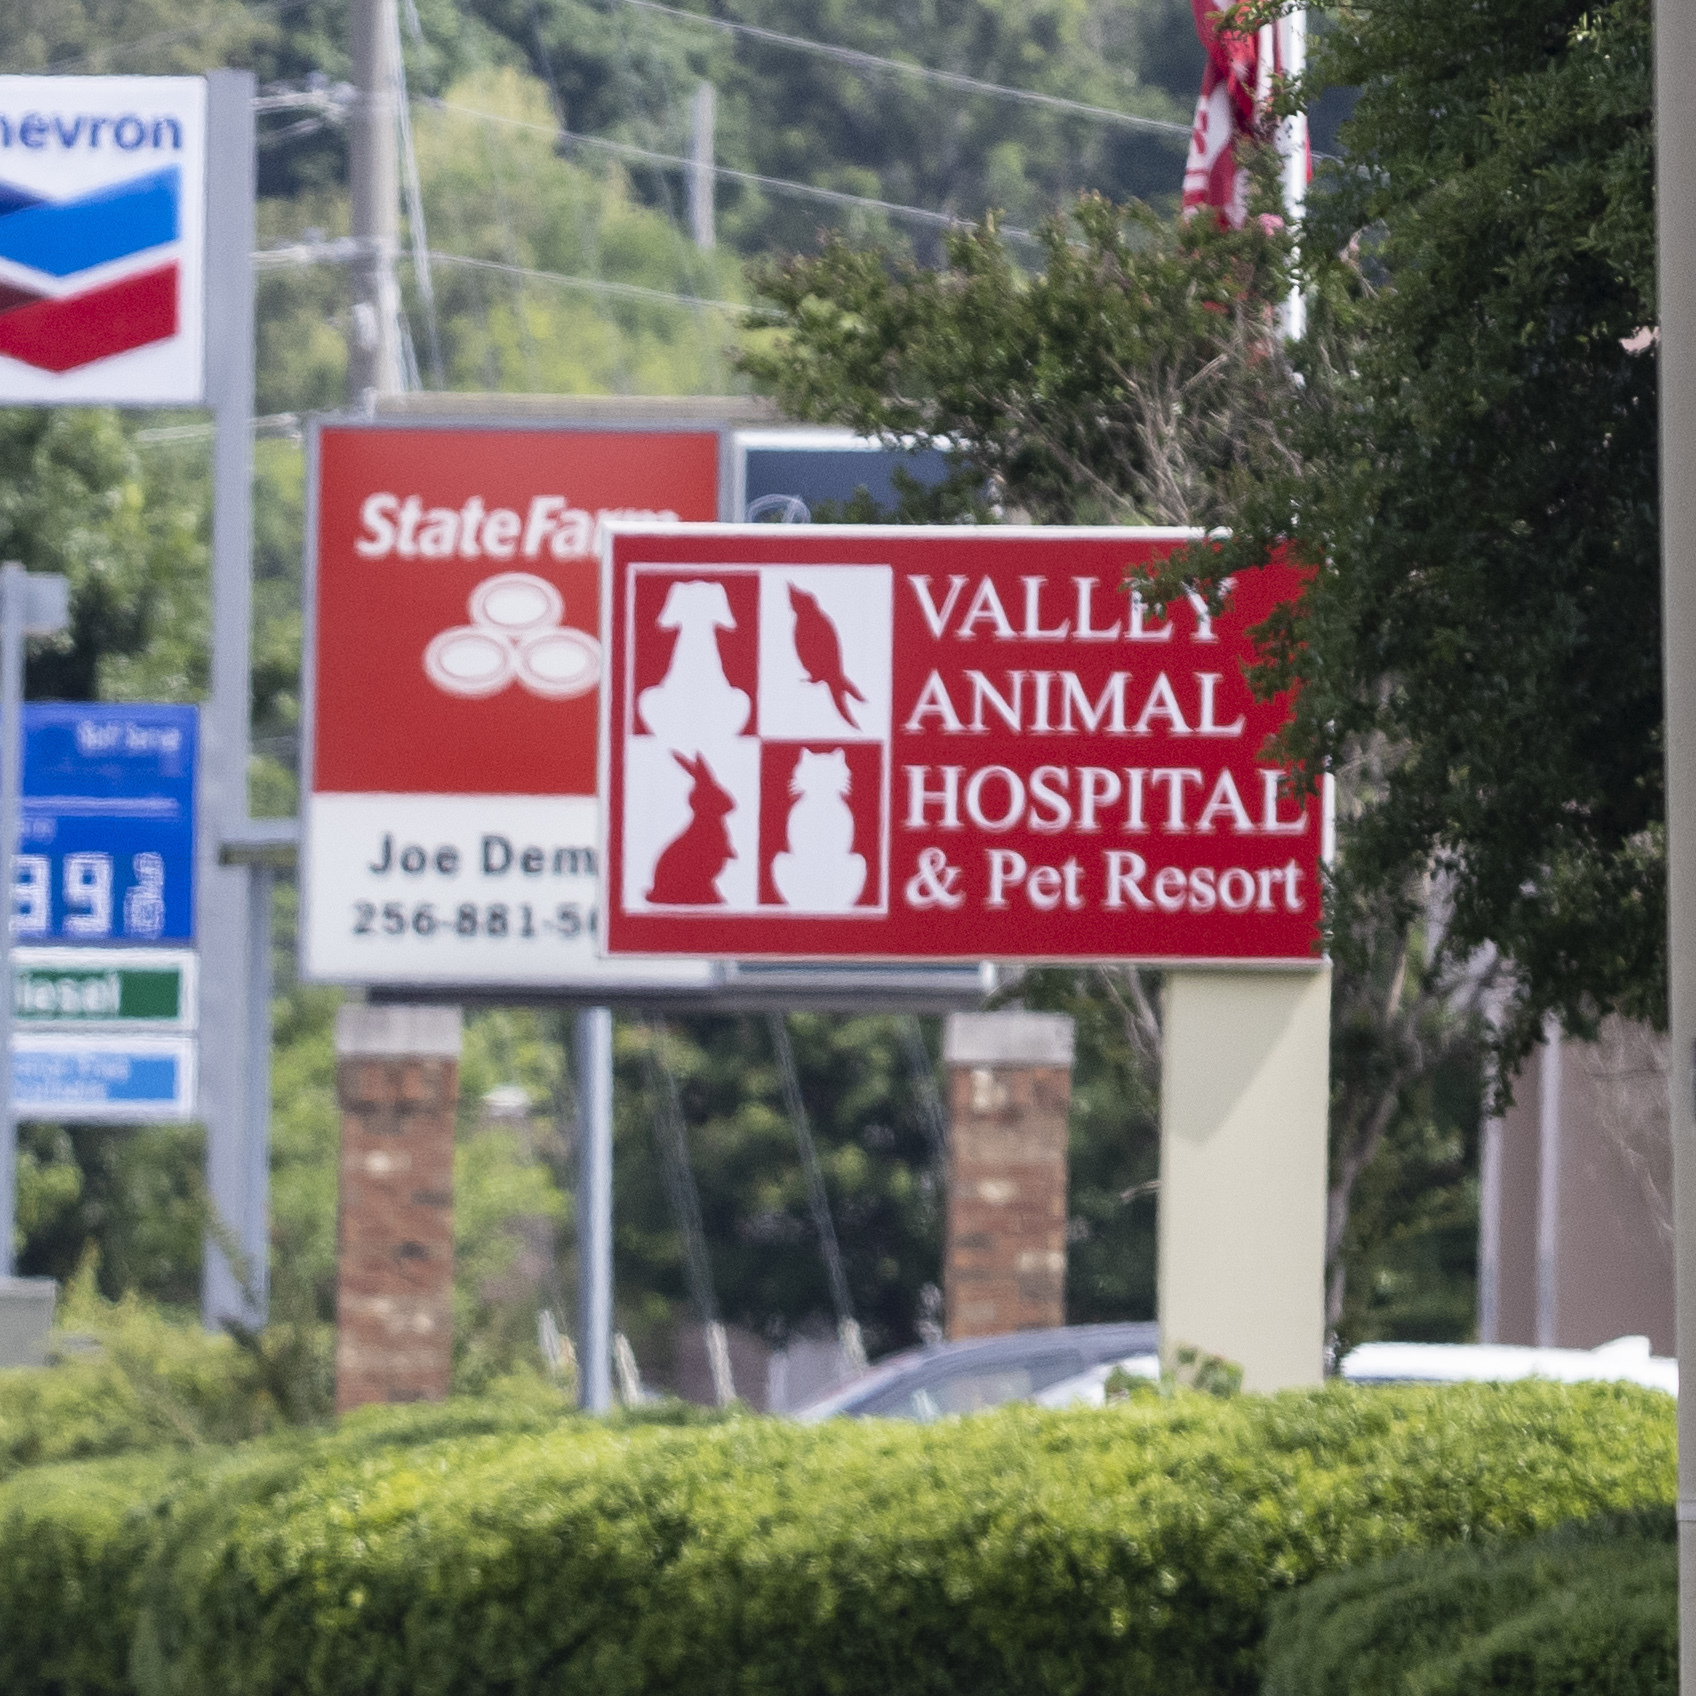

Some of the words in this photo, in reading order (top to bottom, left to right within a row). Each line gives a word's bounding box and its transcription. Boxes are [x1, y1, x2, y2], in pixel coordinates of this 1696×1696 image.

[354, 492, 679, 560] StateFar
[907, 575, 1239, 643] VALLEY
[905, 671, 1246, 737] ANIMAL
[905, 765, 1308, 834] HOSPITAL
[369, 833, 460, 875] Joe
[905, 846, 964, 908] &
[986, 849, 1086, 909] Pet
[1102, 851, 1306, 914] Resort
